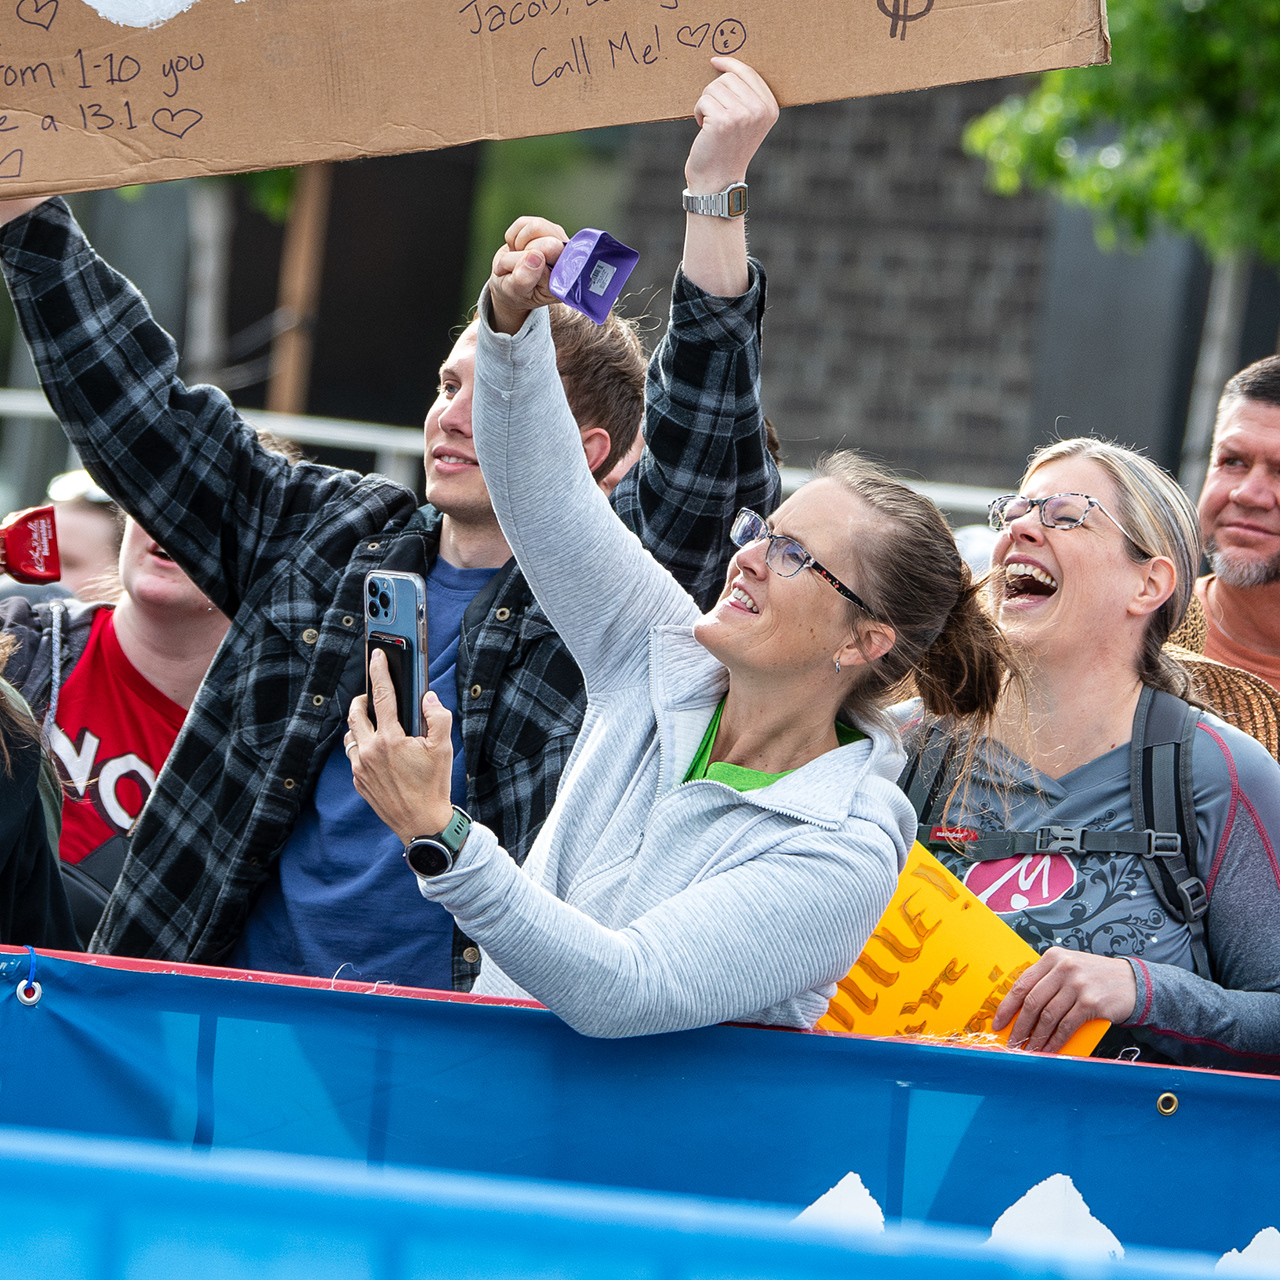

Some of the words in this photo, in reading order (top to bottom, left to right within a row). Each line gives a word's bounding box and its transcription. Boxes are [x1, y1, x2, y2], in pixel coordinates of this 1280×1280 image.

[161, 51, 206, 98] you
[530, 34, 591, 87] Call
[609, 26, 669, 70] Me!
[40, 114, 59, 132] a
